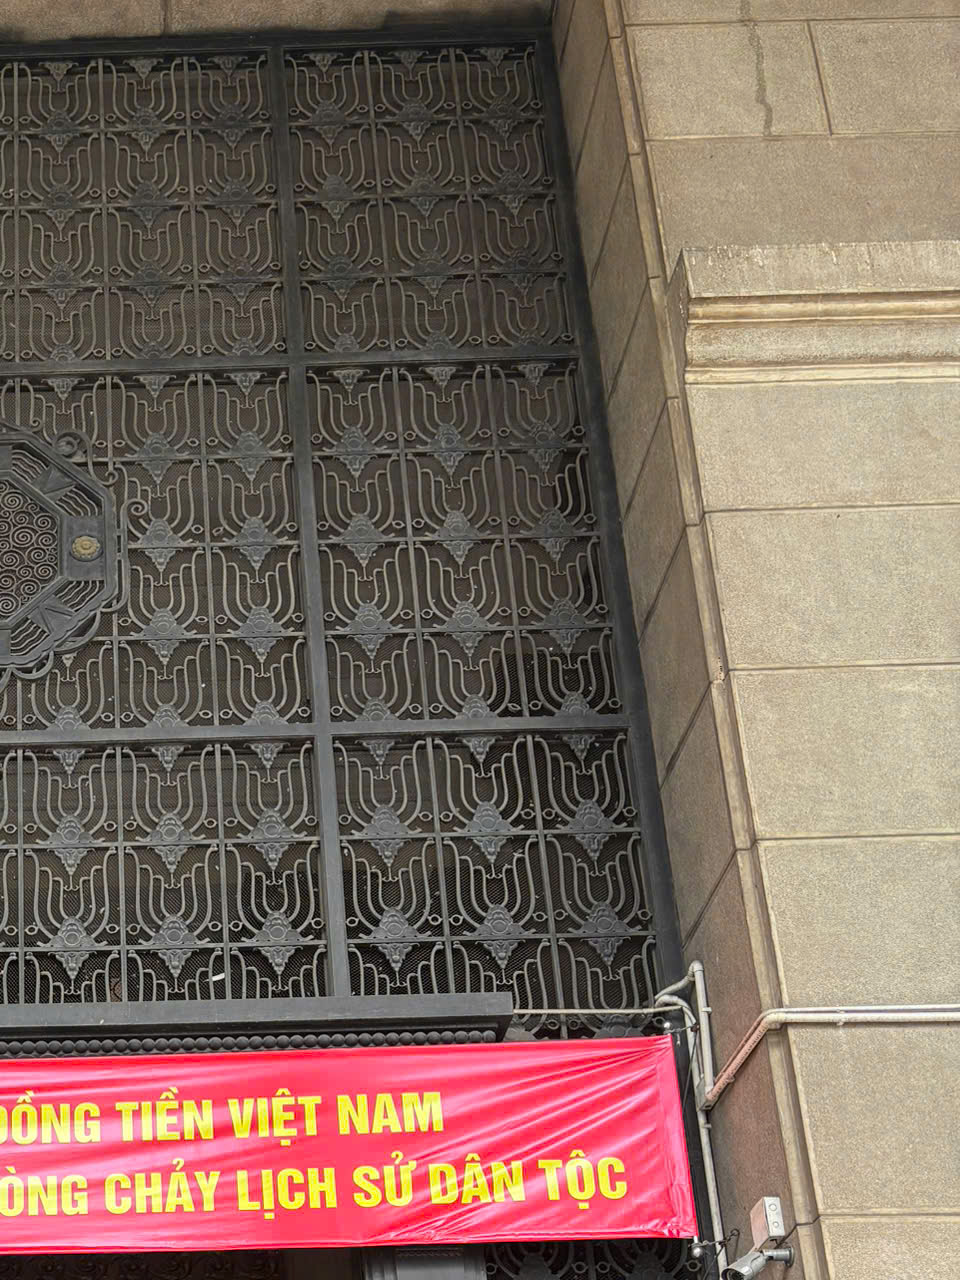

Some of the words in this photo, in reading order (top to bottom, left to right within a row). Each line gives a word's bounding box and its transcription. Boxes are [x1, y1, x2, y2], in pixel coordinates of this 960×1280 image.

[115, 1087, 214, 1142] TIỀN
[228, 1088, 321, 1147] VIỆT
[337, 1092, 444, 1136] NAM
[103, 1158, 221, 1215] CHẢY
[236, 1167, 337, 1220] LỊCH
[353, 1151, 417, 1208] SỬ
[428, 1152, 525, 1205] DÂN
[538, 1149, 628, 1210] TỘC
